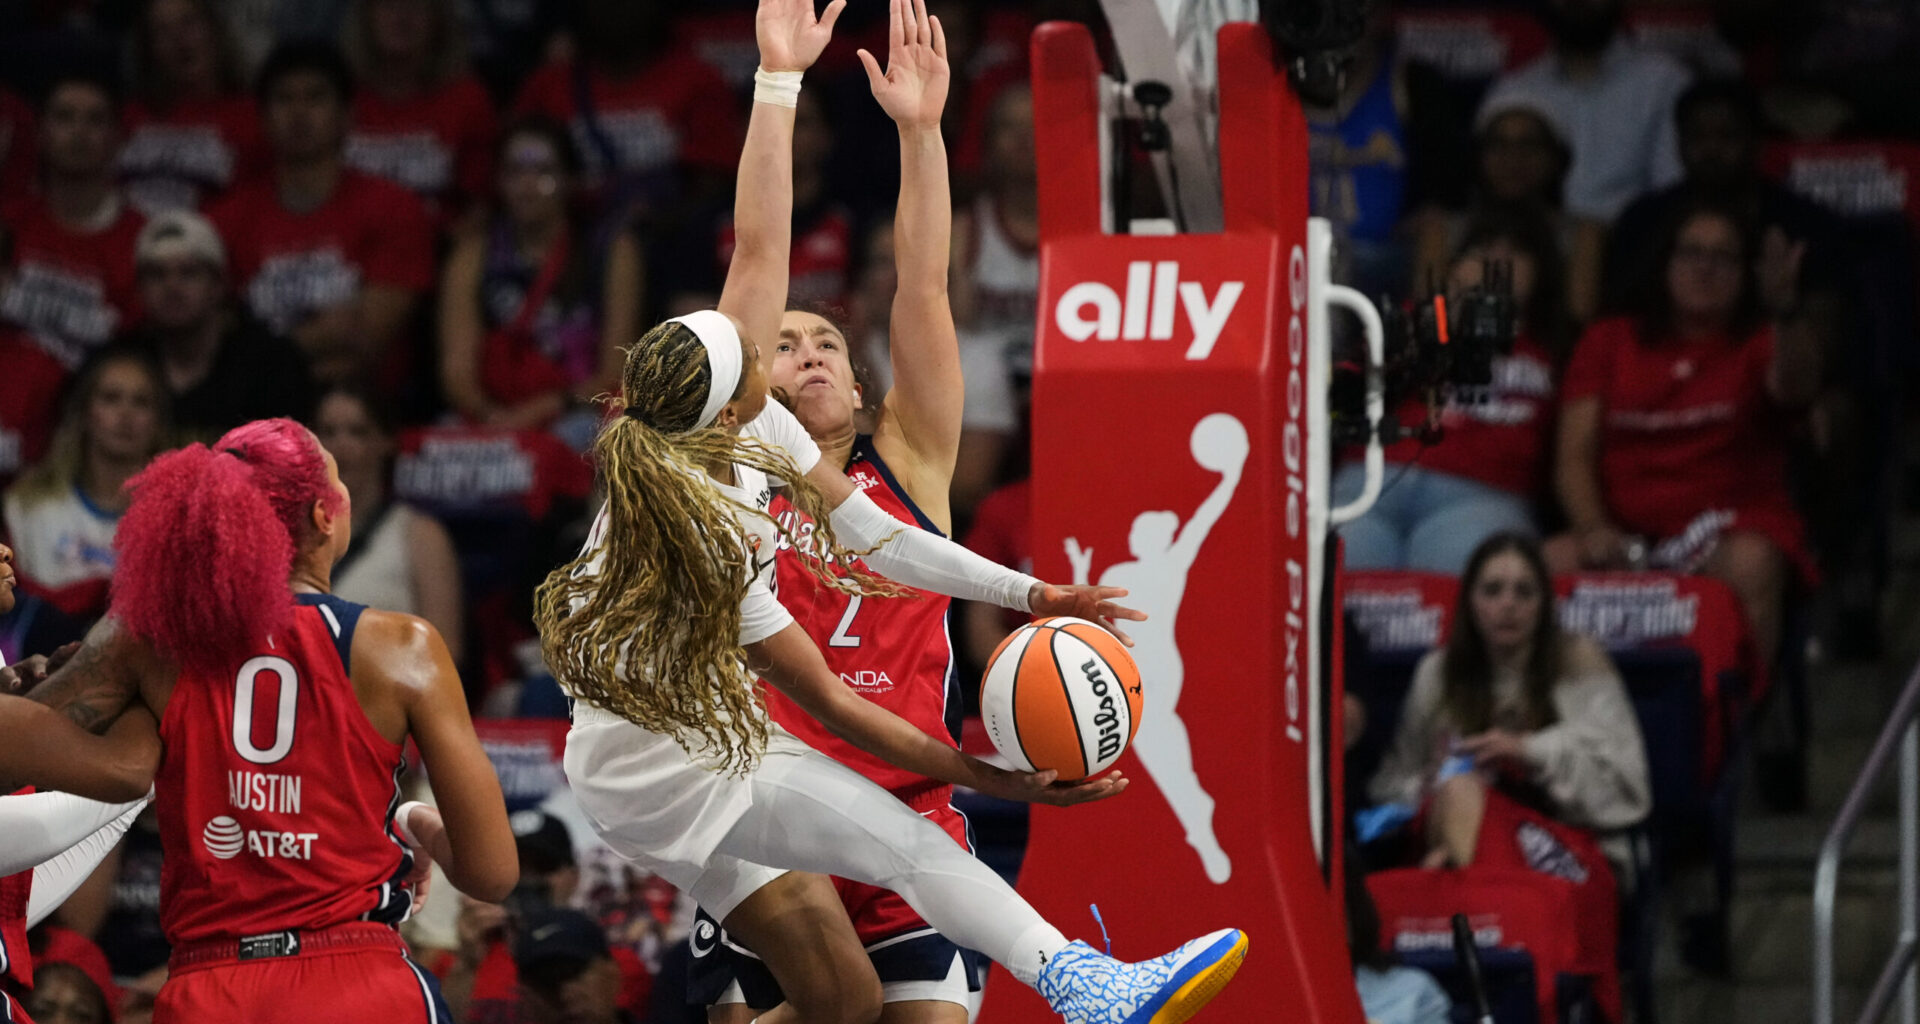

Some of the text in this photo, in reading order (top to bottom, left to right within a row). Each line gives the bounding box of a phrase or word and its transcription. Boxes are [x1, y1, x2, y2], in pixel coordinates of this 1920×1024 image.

[1055, 261, 1244, 360] ally
[1282, 244, 1309, 742] Google Pixel
[828, 577, 863, 648] 2
[232, 655, 299, 765] 0
[840, 670, 894, 686] NDA
[1081, 658, 1121, 764] Wilson
[228, 769, 301, 815] AUSTIN
[248, 829, 319, 860] AT&T
